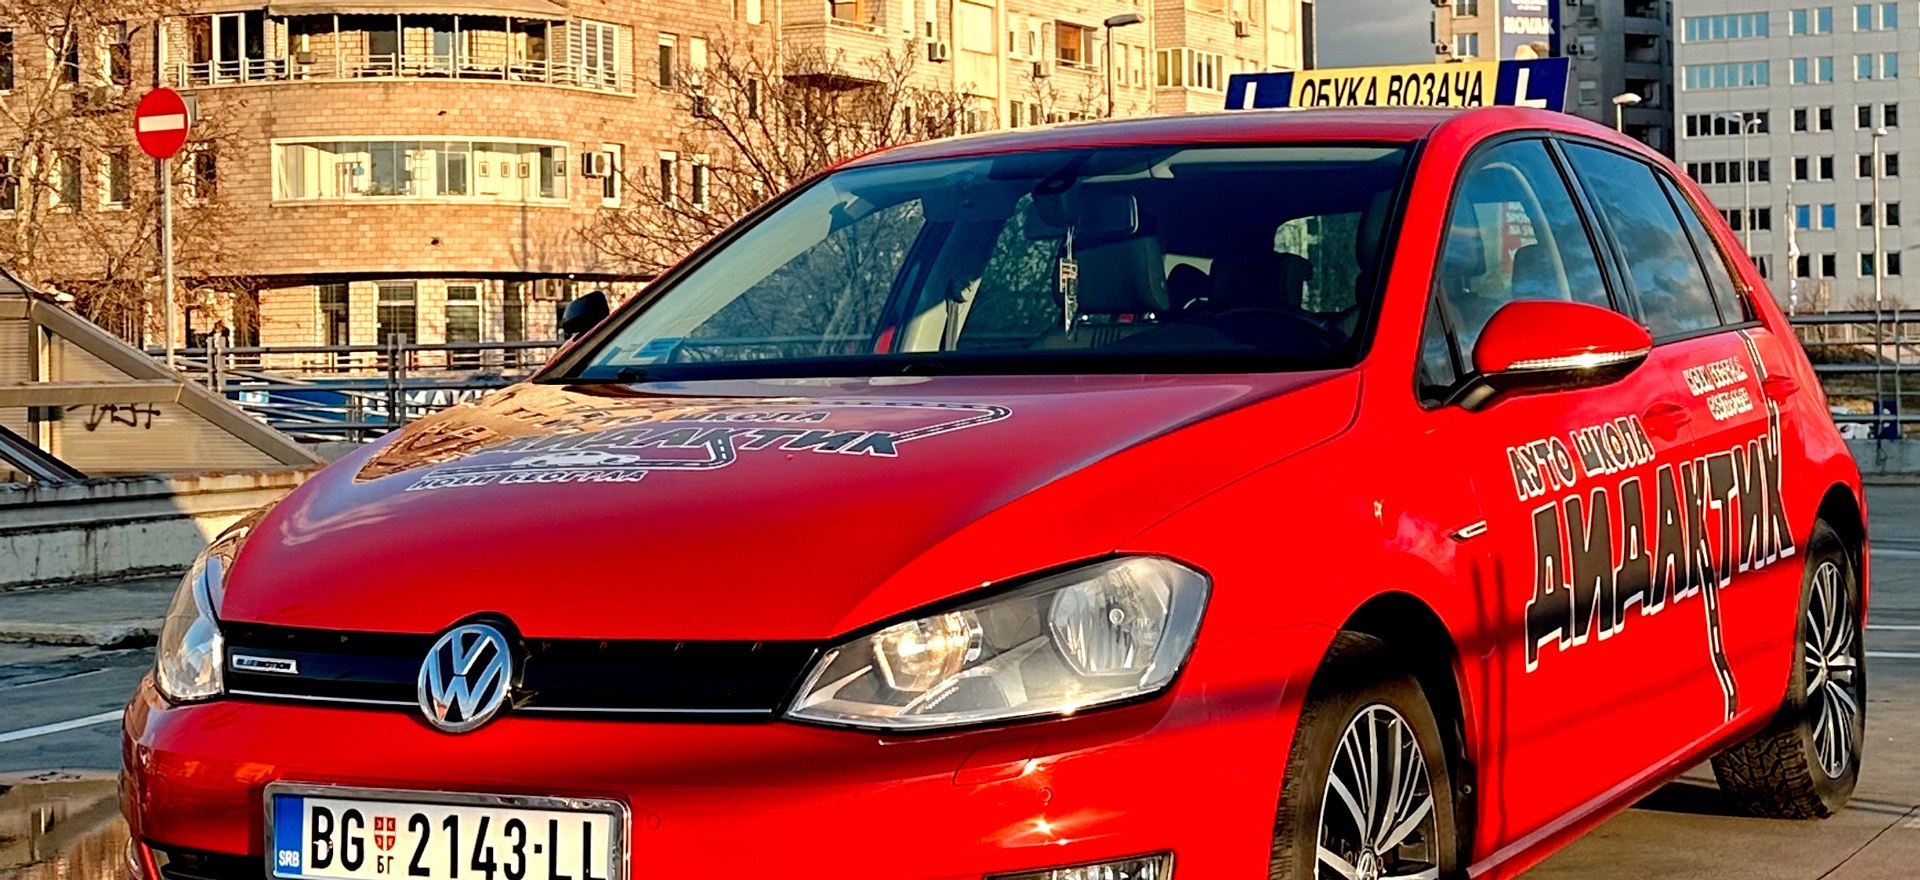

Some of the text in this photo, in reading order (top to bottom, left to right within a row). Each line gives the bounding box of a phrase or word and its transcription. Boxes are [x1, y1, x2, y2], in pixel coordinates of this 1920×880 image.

[1503, 16, 1555, 34] NOVAK
[1301, 70, 1482, 107] ОБУКА ВОЗАЧА
[1514, 67, 1548, 108] L
[662, 411, 829, 423] ШКОЛА
[1506, 413, 1656, 501] АУТО ШКОЛА
[405, 469, 649, 492] НОВИ БЕОГРАД
[1525, 433, 1796, 673] ДИДАКТИК
[311, 805, 365, 872] BG
[279, 849, 300, 867] SRB
[377, 854, 395, 875] БГ
